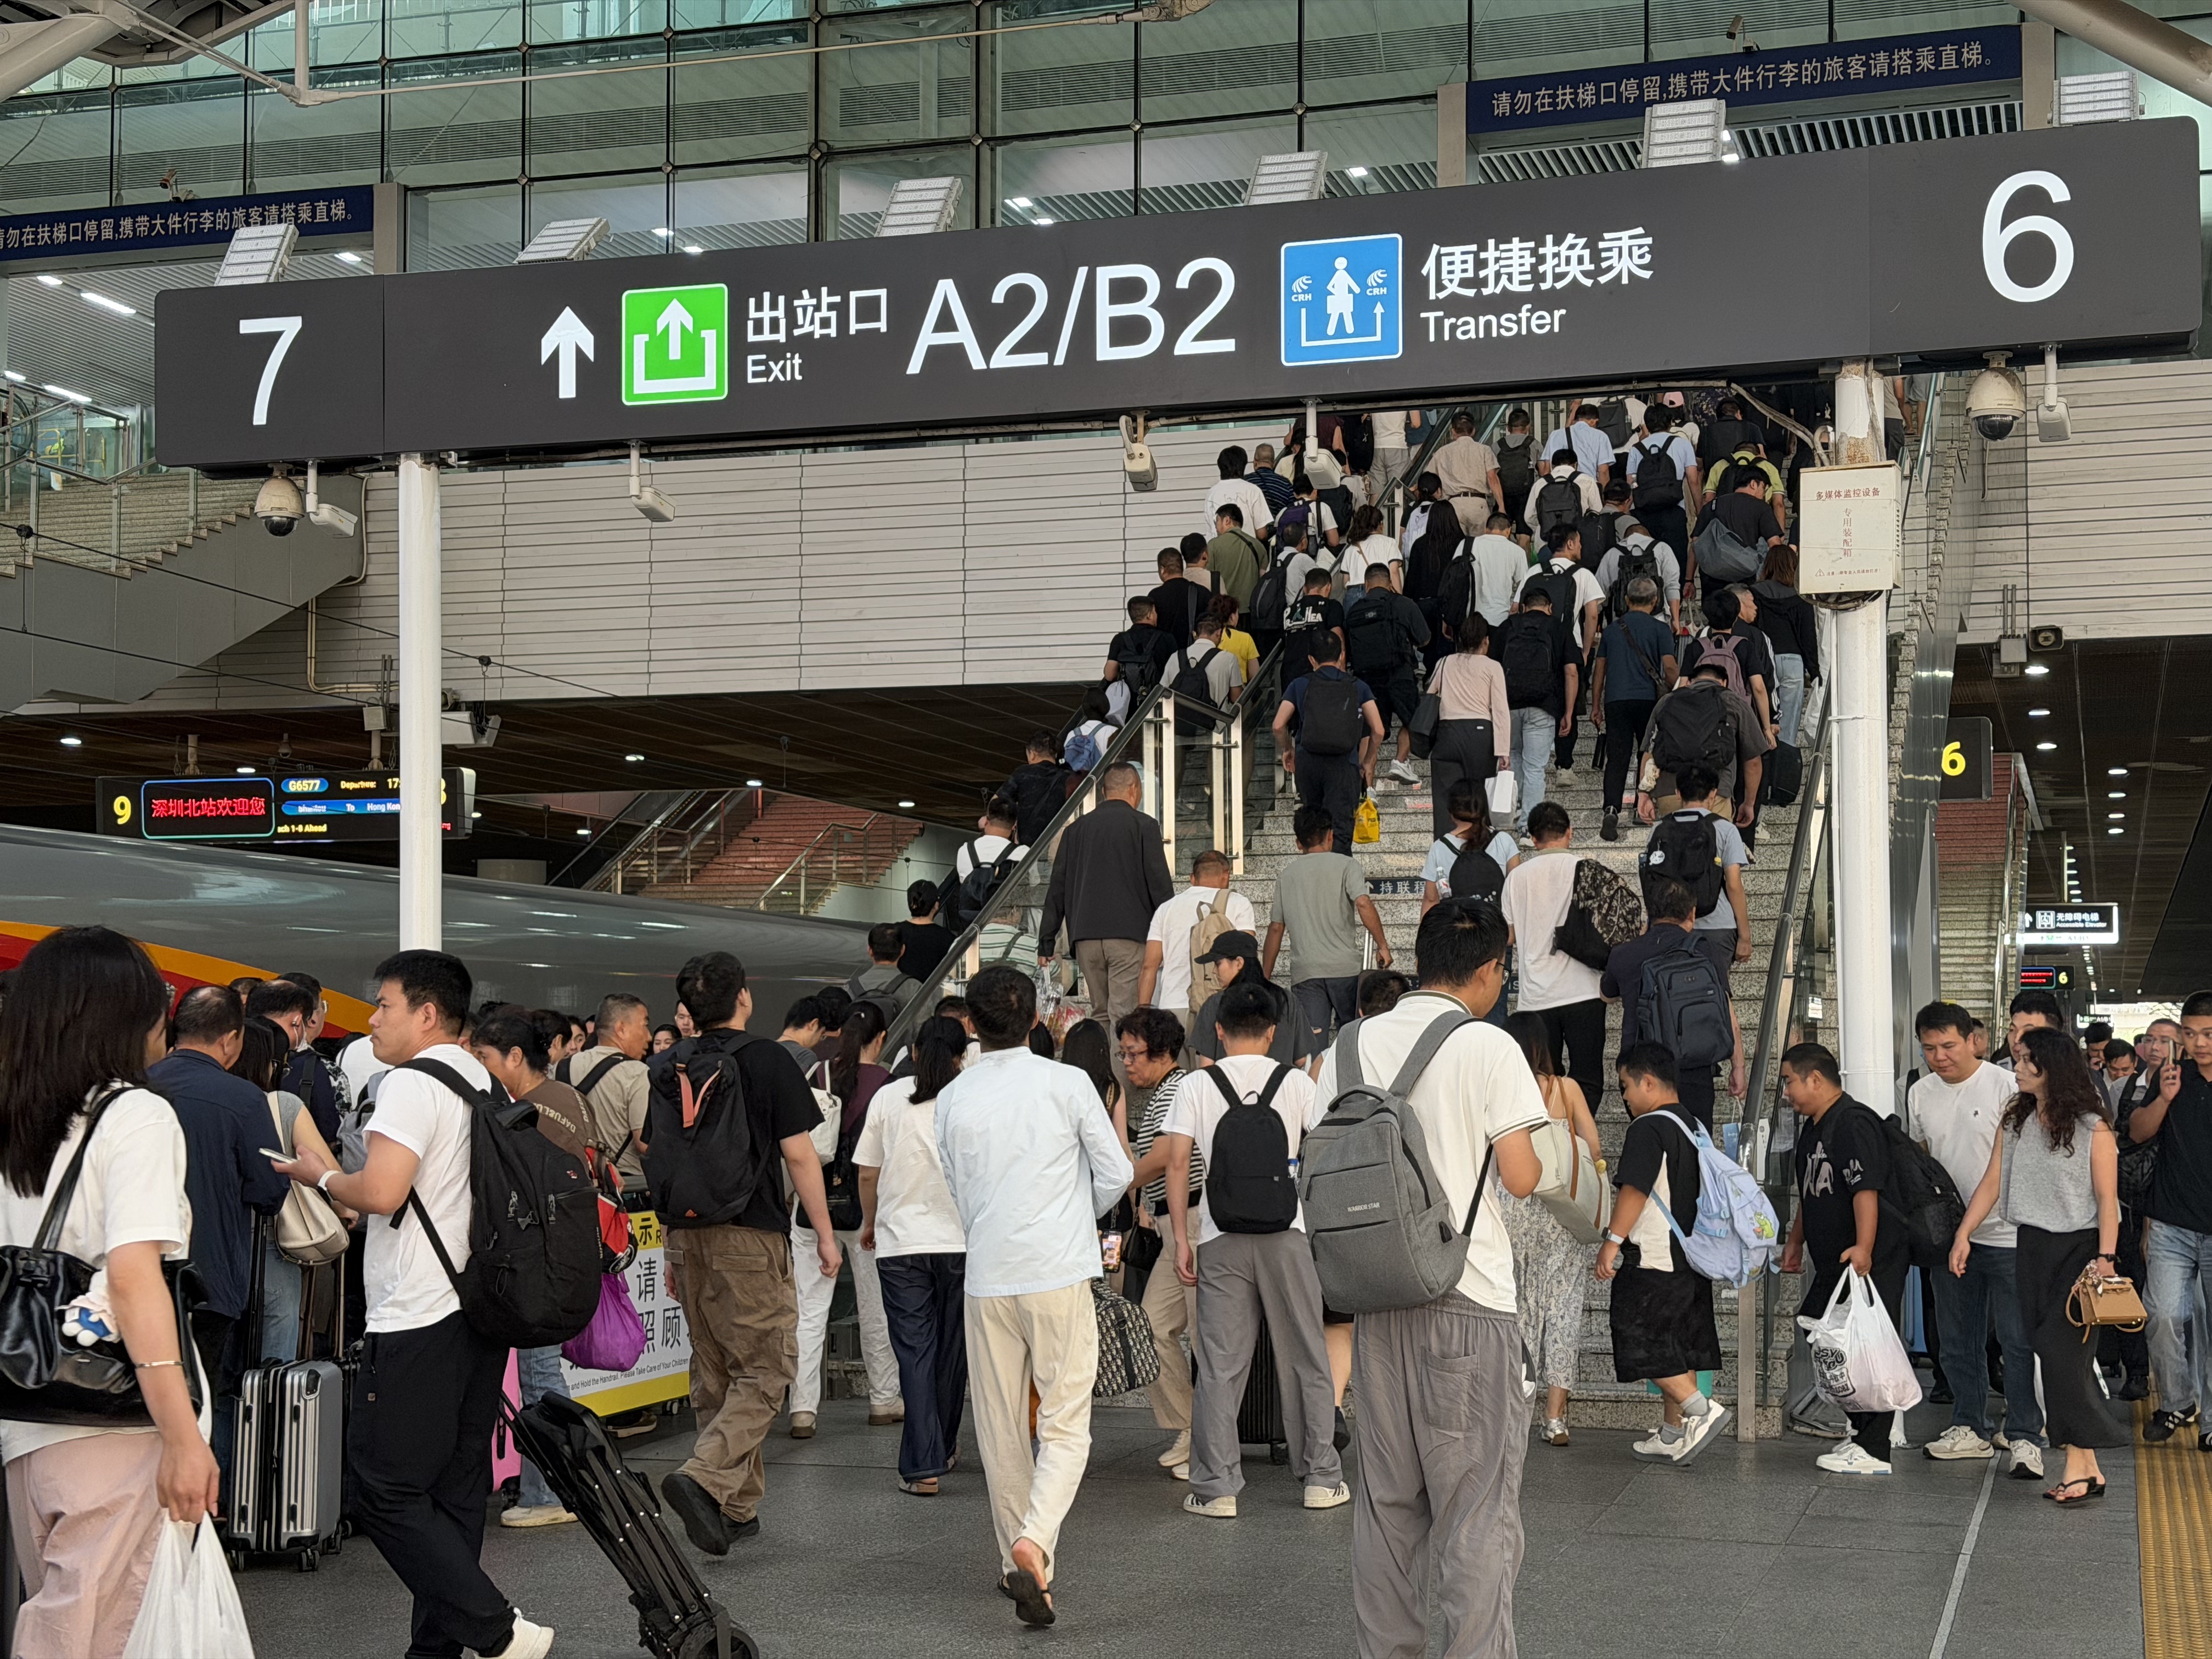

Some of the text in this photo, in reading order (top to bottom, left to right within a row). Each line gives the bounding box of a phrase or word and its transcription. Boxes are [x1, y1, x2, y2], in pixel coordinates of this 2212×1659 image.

[1982, 171, 2075, 303] 6
[1421, 227, 1654, 300] 便捷换乘
[1291, 293, 1312, 302] CRH
[1367, 286, 1387, 295] CRH
[747, 286, 887, 342] 出站口
[906, 257, 1235, 375] A2/B2
[1420, 304, 1566, 342] Transfer
[239, 315, 302, 426] 7
[747, 353, 803, 383] Exit
[1816, 487, 1881, 500] 多媒体监控设备
[1842, 507, 1852, 557] 专用装配箱
[1942, 742, 1966, 776] 6
[289, 780, 320, 792] G6577
[114, 795, 131, 825] 9
[151, 797, 266, 817] 深圳北站欢迎您
[346, 803, 356, 811] To
[367, 803, 385, 812] Hong
[387, 802, 400, 810] Kon
[2058, 972, 2068, 984] 6
[638, 1306, 690, 1355] 照顾
[571, 1380, 580, 1391] and
[580, 1378, 591, 1389] Hold
[636, 1367, 646, 1375] Take
[646, 1364, 657, 1373] Care
[657, 1363, 662, 1371] of
[662, 1361, 671, 1370] Your
[672, 1358, 689, 1368] Children
